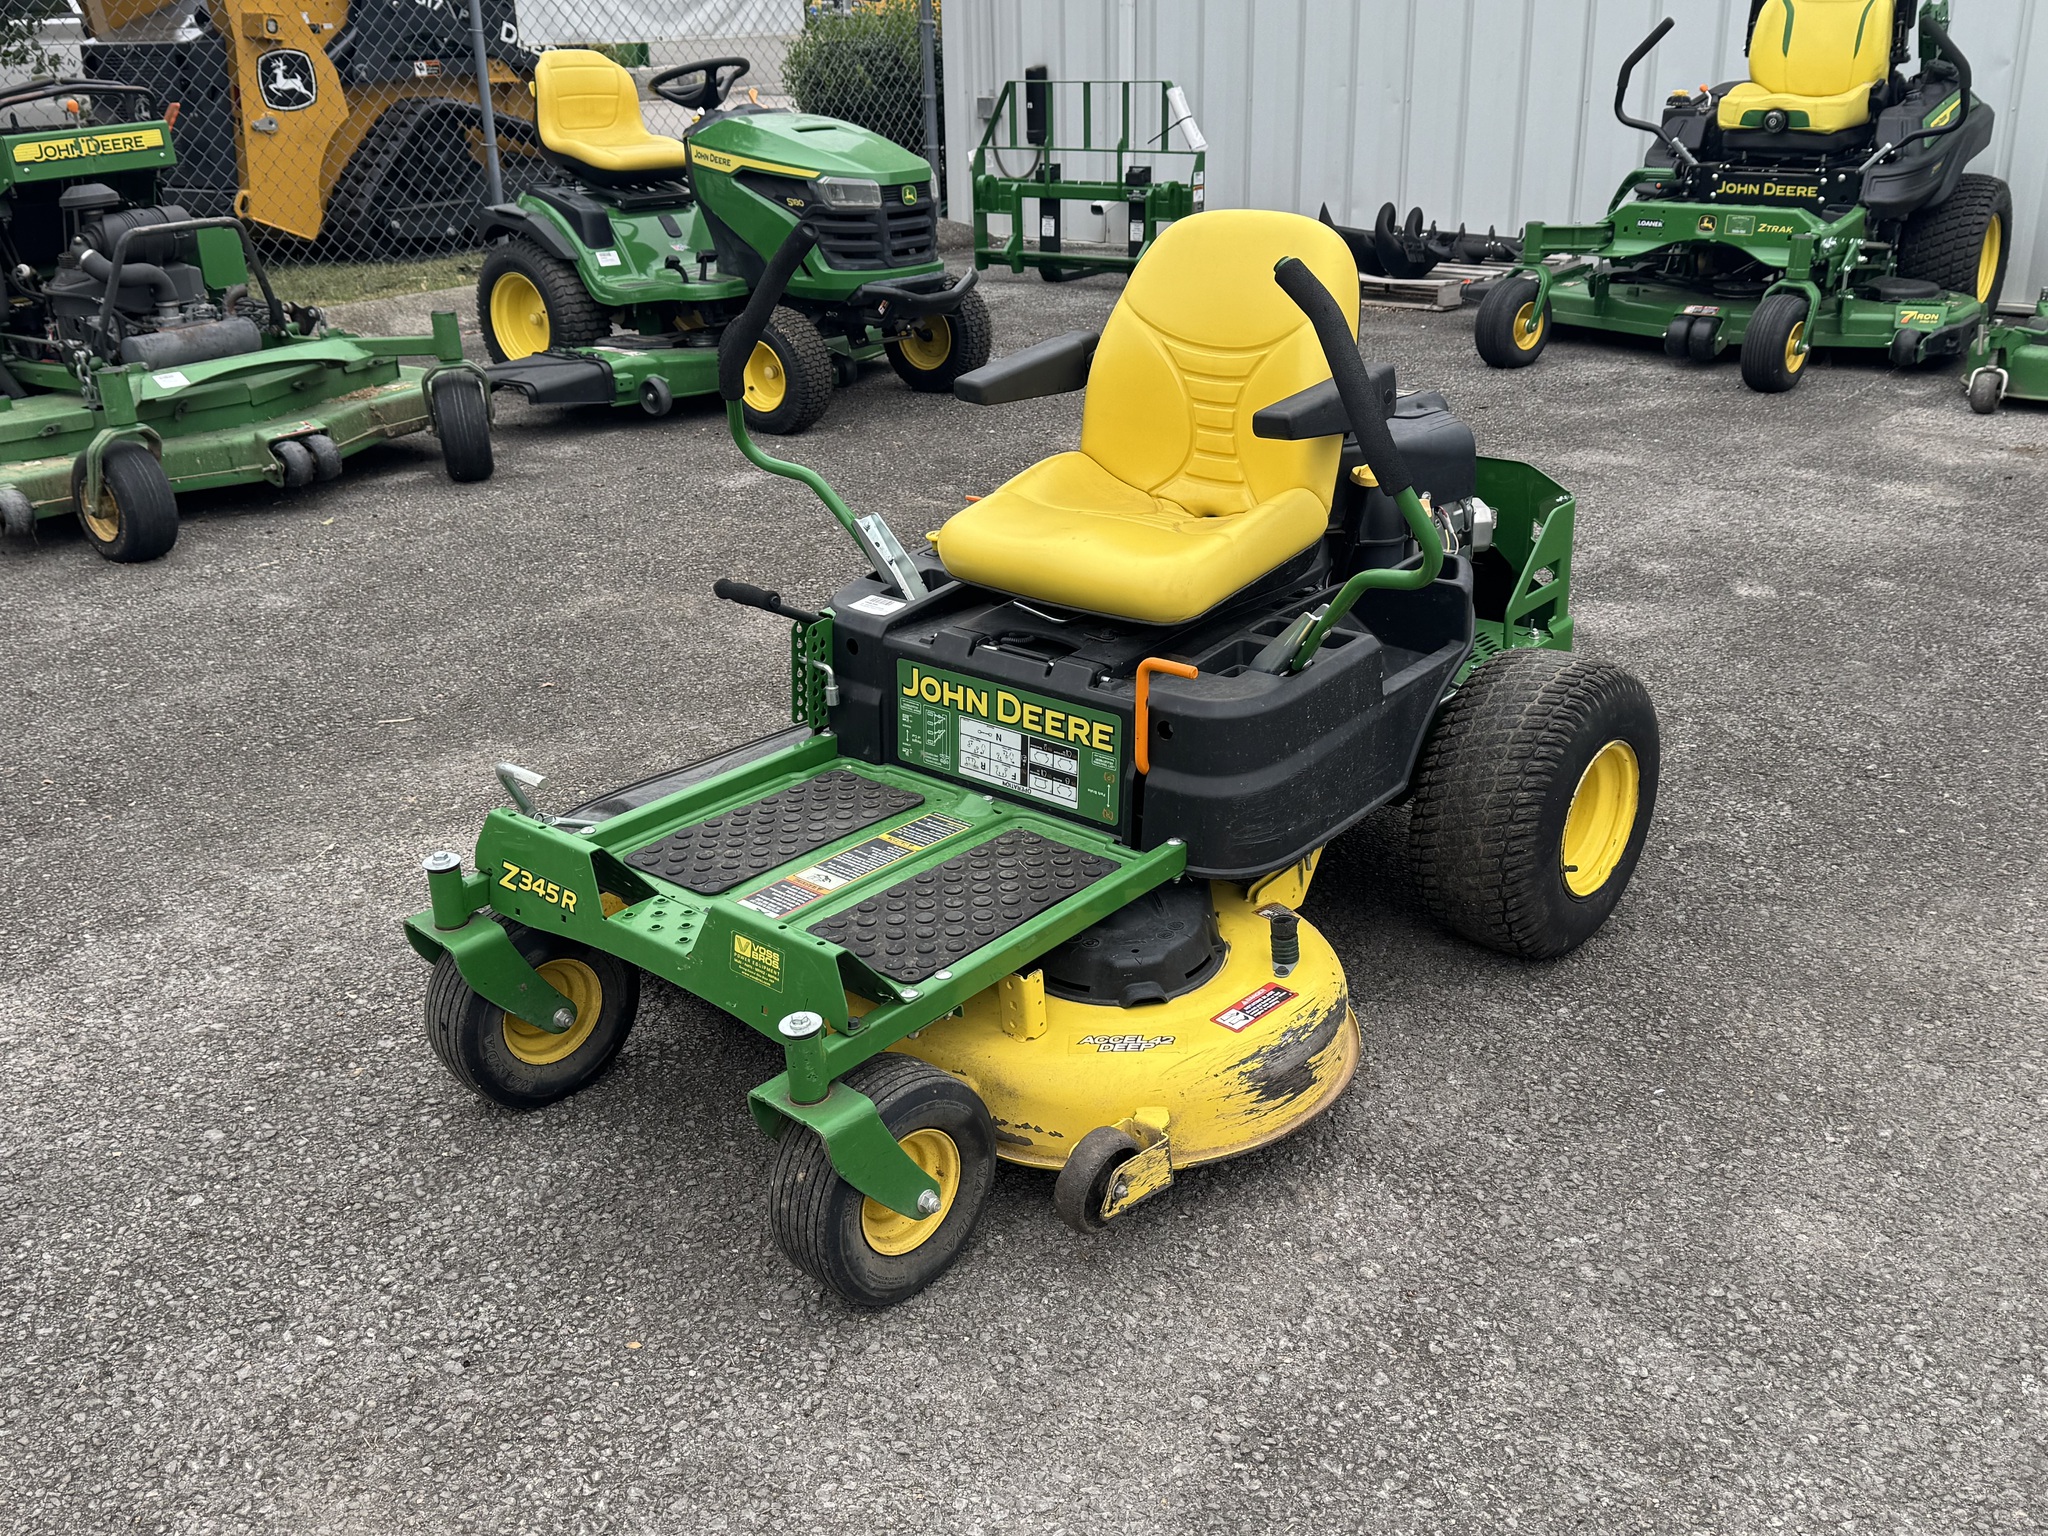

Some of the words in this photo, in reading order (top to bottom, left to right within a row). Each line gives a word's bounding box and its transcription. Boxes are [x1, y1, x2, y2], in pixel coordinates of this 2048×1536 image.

[35, 139, 82, 161] JOHN
[87, 135, 145, 155] DEERE
[694, 149, 710, 161] JOHN
[710, 153, 732, 167] DEERE
[1716, 180, 1760, 195] JOHN
[1763, 183, 1819, 198] DEERE
[1637, 220, 1663, 228] LOANER
[902, 667, 988, 718] JOHN
[996, 690, 1114, 753] DEERE
[1002, 781, 1032, 795] OPERATION
[752, 943, 780, 962] VOSS
[752, 960, 780, 977] EQUIPMENT
[1078, 1035, 1147, 1045] ACCEL
[1097, 1043, 1155, 1053] DEEP
[483, 1033, 534, 1093] WANDA
[942, 1158, 989, 1253] WANDA
